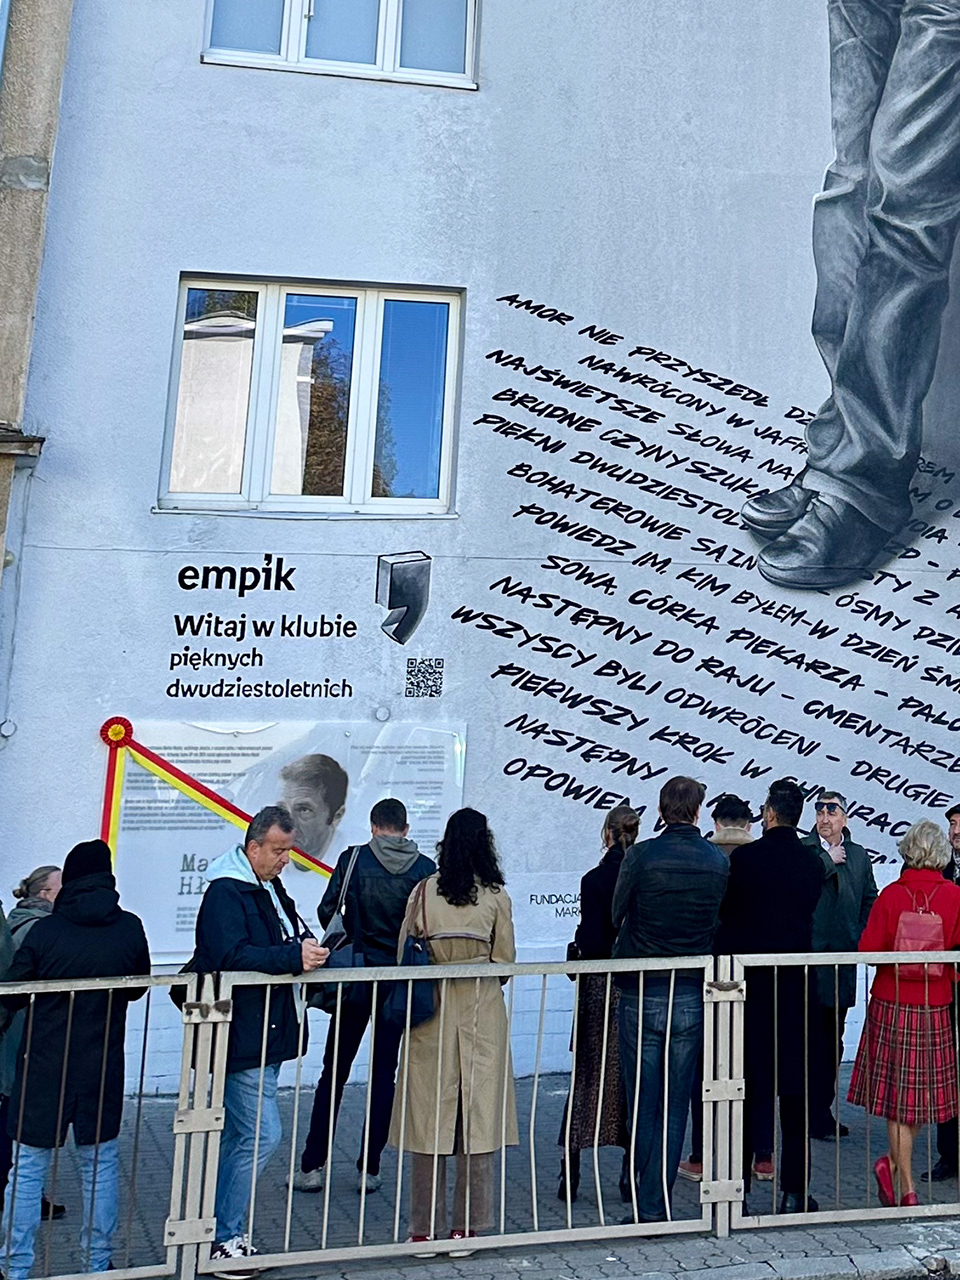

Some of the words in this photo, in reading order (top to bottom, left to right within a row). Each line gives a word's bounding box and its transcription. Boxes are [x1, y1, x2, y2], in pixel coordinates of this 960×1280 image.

[496, 294, 574, 326] AMOR
[578, 325, 624, 345] NIE
[628, 346, 769, 407] PRZYSZEDŁ
[492, 388, 602, 432] BRUDNE
[578, 355, 726, 417] NAWRÓCONY
[726, 413, 754, 428] W
[934, 500, 953, 510] O
[667, 422, 754, 463] SŁOWA
[758, 458, 795, 481] NA
[473, 414, 567, 454] PIĘKNI
[913, 589, 940, 605] Z
[506, 462, 691, 540] BOHATEROWIE
[726, 548, 757, 571] ZN
[835, 593, 911, 631] ÓSMY
[178, 554, 296, 597] empik
[512, 503, 636, 556] POWIEDZ
[676, 567, 732, 597] KIM
[840, 633, 919, 672] DZIEŃ
[170, 646, 263, 670] pięknych
[174, 613, 246, 642] Witaj
[252, 619, 275, 637] w
[281, 614, 358, 638] klubie
[489, 576, 653, 645] NASTĘPNY
[652, 639, 694, 663] DO
[694, 656, 775, 696] RAJU
[628, 589, 720, 635] CÓRKA
[725, 627, 865, 691] PIEKARZA
[166, 677, 353, 698] dwudziestoletnich
[451, 605, 597, 668] WSZYSCY
[593, 660, 662, 695] BYLI
[664, 688, 821, 757] ODWRÓCENI
[850, 760, 953, 808] DRUGIE
[490, 663, 649, 731] PIERWSZY
[649, 725, 734, 764] KROK
[740, 758, 772, 778] W
[503, 713, 668, 780] NASTĘPNY
[180, 853, 215, 872] Ma
[530, 893, 581, 905] FUNDACJA
